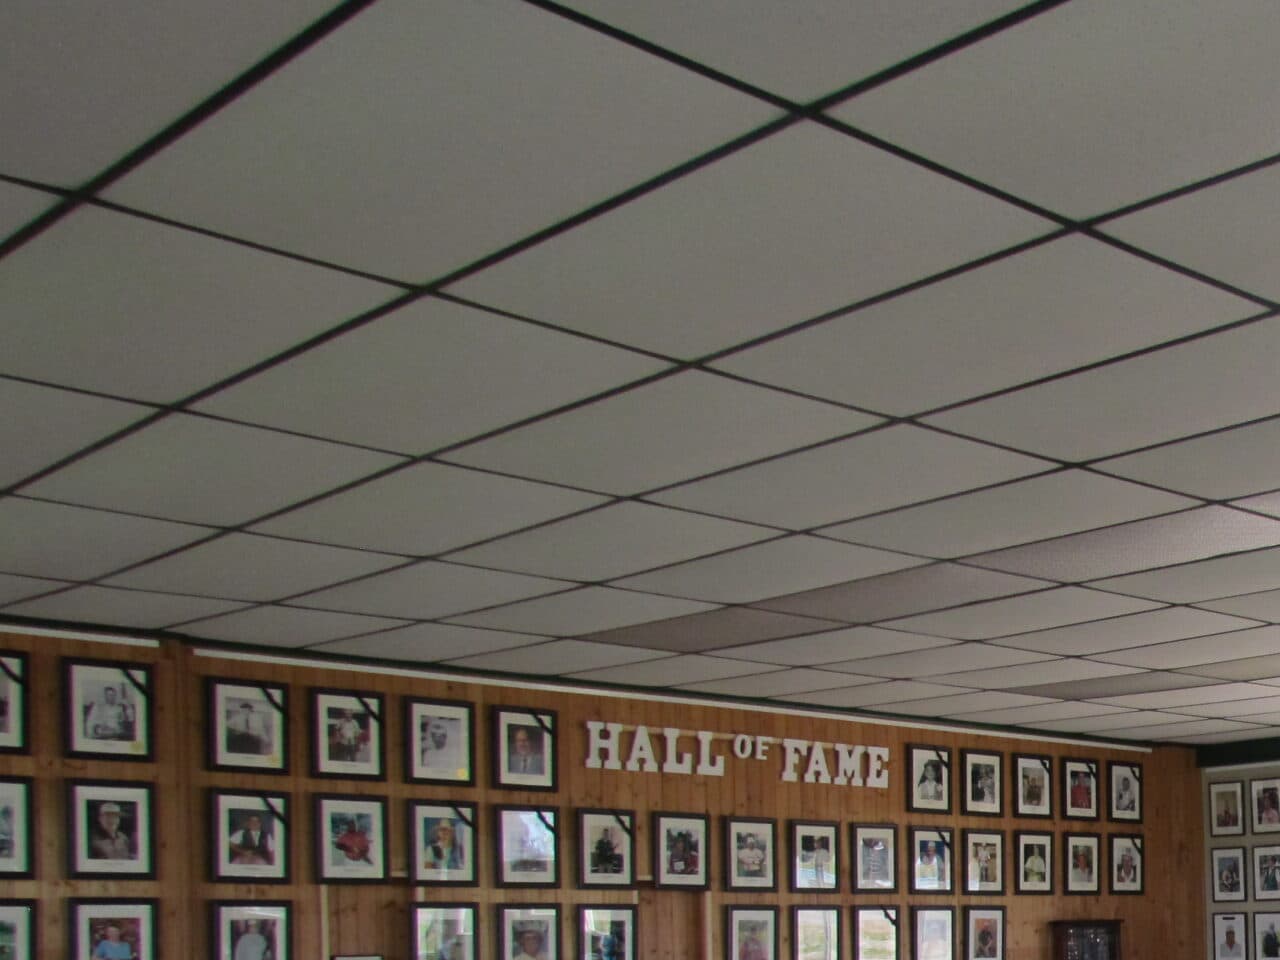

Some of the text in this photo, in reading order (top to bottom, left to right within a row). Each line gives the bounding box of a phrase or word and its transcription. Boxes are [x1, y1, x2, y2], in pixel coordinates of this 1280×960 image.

[586, 721, 889, 788] HALL OF FAME
